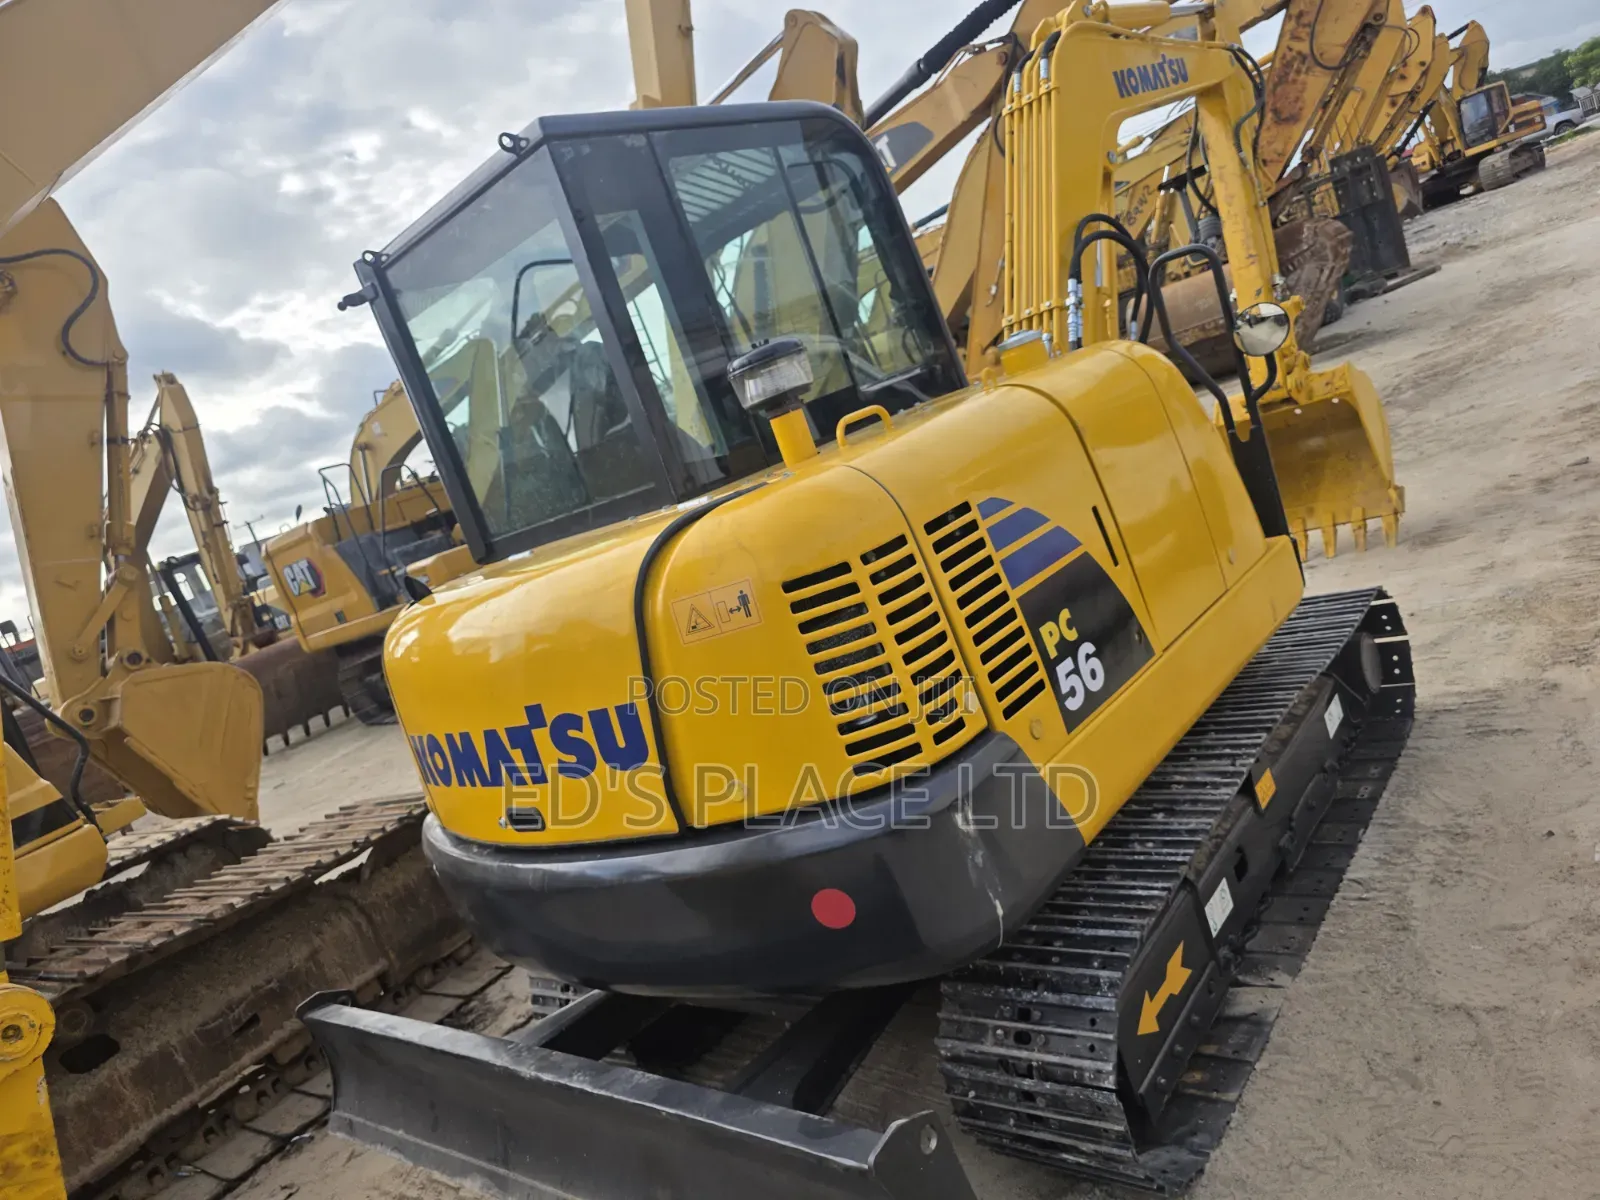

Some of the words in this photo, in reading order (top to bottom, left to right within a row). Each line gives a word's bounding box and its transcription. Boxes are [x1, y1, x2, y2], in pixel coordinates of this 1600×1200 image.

[1112, 53, 1188, 98] KOMATSU
[283, 559, 317, 596] CAT
[1039, 608, 1079, 660] PC
[1055, 641, 1105, 712] 56
[409, 703, 649, 787] KOMATSU
